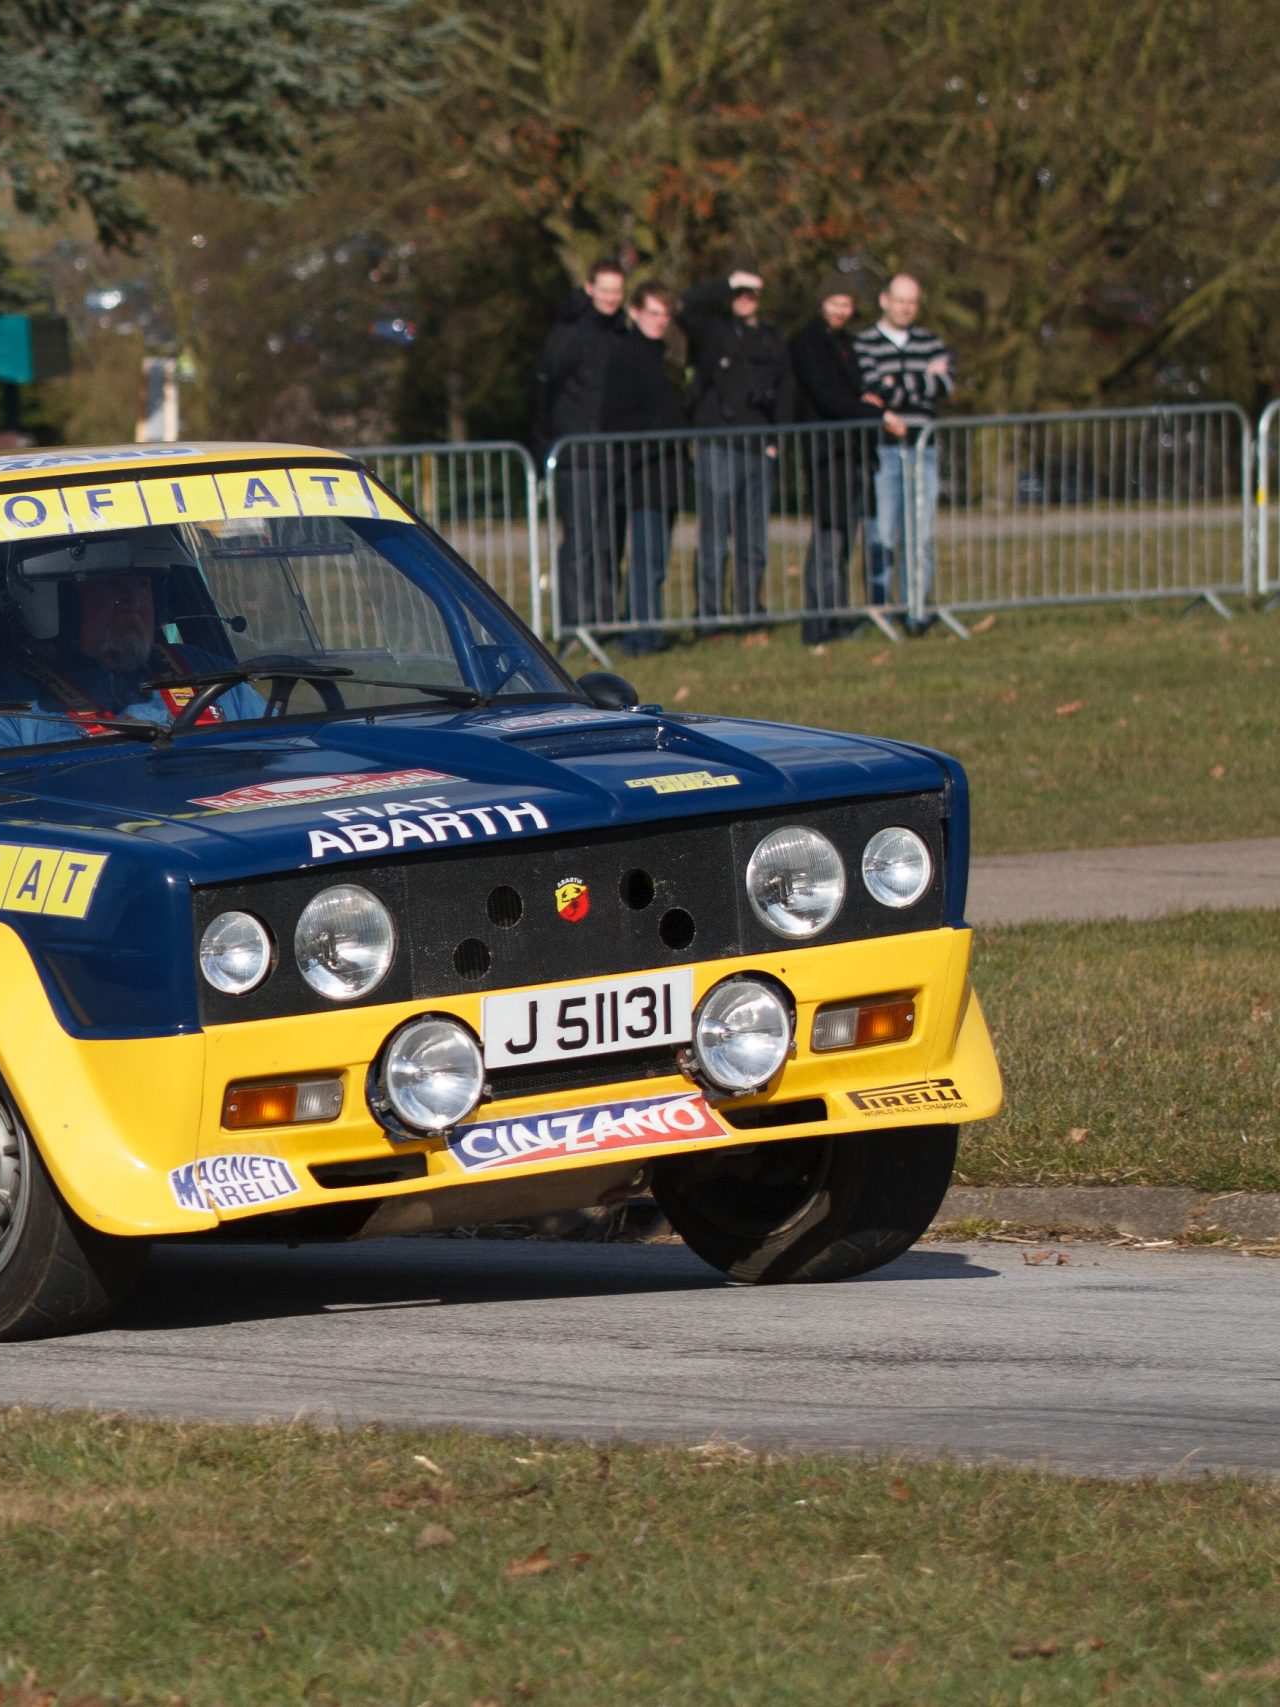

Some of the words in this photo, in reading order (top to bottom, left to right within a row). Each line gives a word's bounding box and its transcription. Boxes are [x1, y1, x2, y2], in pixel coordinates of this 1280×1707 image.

[204, 790, 303, 809] RALLYE
[320, 771, 447, 795] PORTUGAL
[632, 772, 705, 786] OLIO
[659, 777, 730, 791] FIAT
[321, 796, 452, 823] FIAT
[308, 801, 549, 858] ABARTH
[506, 1000, 538, 1055] J
[556, 985, 673, 1052] 51131
[846, 1078, 962, 1110] PIRELLI
[864, 1107, 895, 1117] WORLD
[896, 1105, 921, 1113] RALLY
[923, 1101, 968, 1111] CHAMPION
[460, 1096, 705, 1160] CINZANO
[171, 1156, 298, 1197] MAGNETI
[172, 1172, 298, 1210] MARELLI
